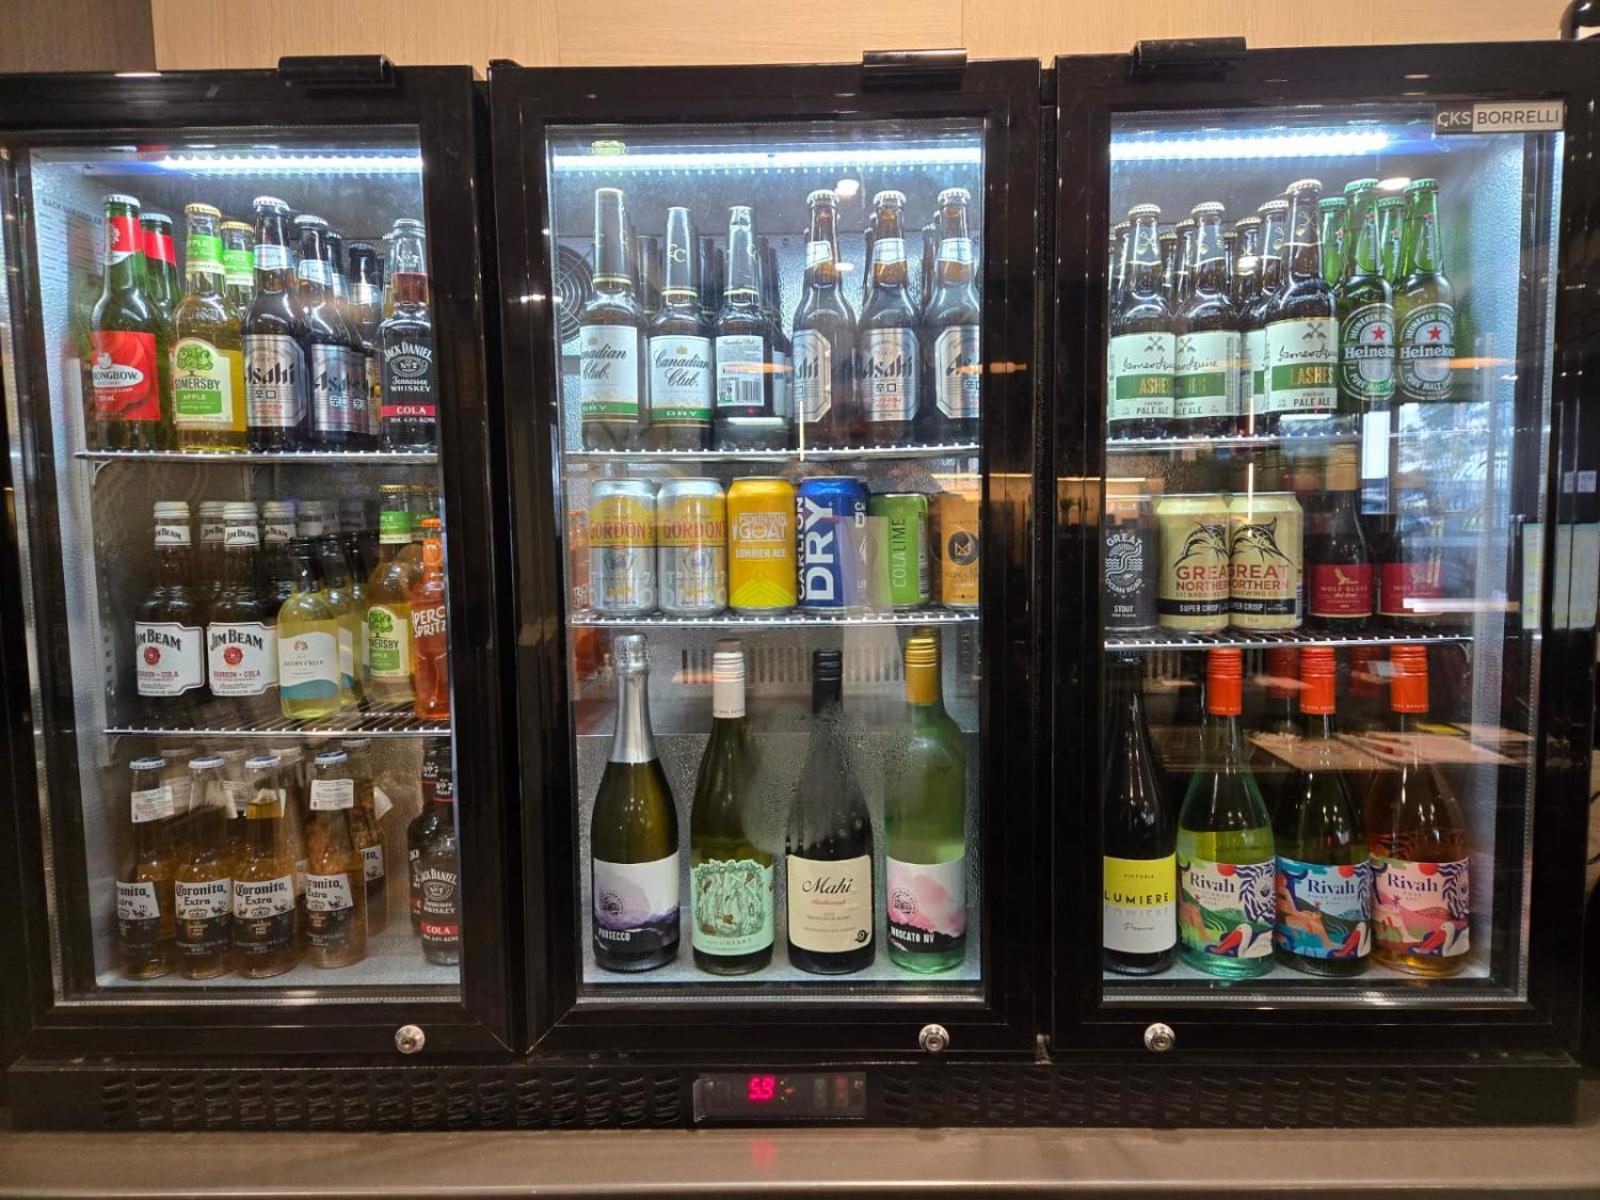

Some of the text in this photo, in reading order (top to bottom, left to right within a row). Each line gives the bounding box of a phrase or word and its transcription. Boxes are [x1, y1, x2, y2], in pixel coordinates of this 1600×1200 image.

[1477, 110, 1558, 125] BORRELLI
[653, 349, 709, 369] Canadian
[861, 354, 914, 380] Asahi
[664, 367, 696, 387] Club
[390, 385, 431, 393] WHISKEY
[396, 406, 426, 416] COLA
[1293, 398, 1316, 408] PALE
[1106, 533, 1143, 547] GREAT
[805, 497, 834, 600] DRY
[1114, 605, 1135, 614] STOUT
[147, 628, 182, 652] BEAM
[210, 628, 264, 652] JIM BEAM
[175, 884, 224, 898] Coronita
[236, 881, 287, 898] Coronita
[802, 876, 853, 895] Mahi
[1189, 872, 1234, 894] Rivah
[1306, 879, 1355, 895] Rivah
[1387, 873, 1438, 893] Rivah
[184, 897, 211, 907] Extra
[245, 897, 272, 906] Extra
[1104, 889, 1169, 905] LUMIERE
[427, 925, 451, 936] COLA
[597, 928, 630, 942] PROSECCO
